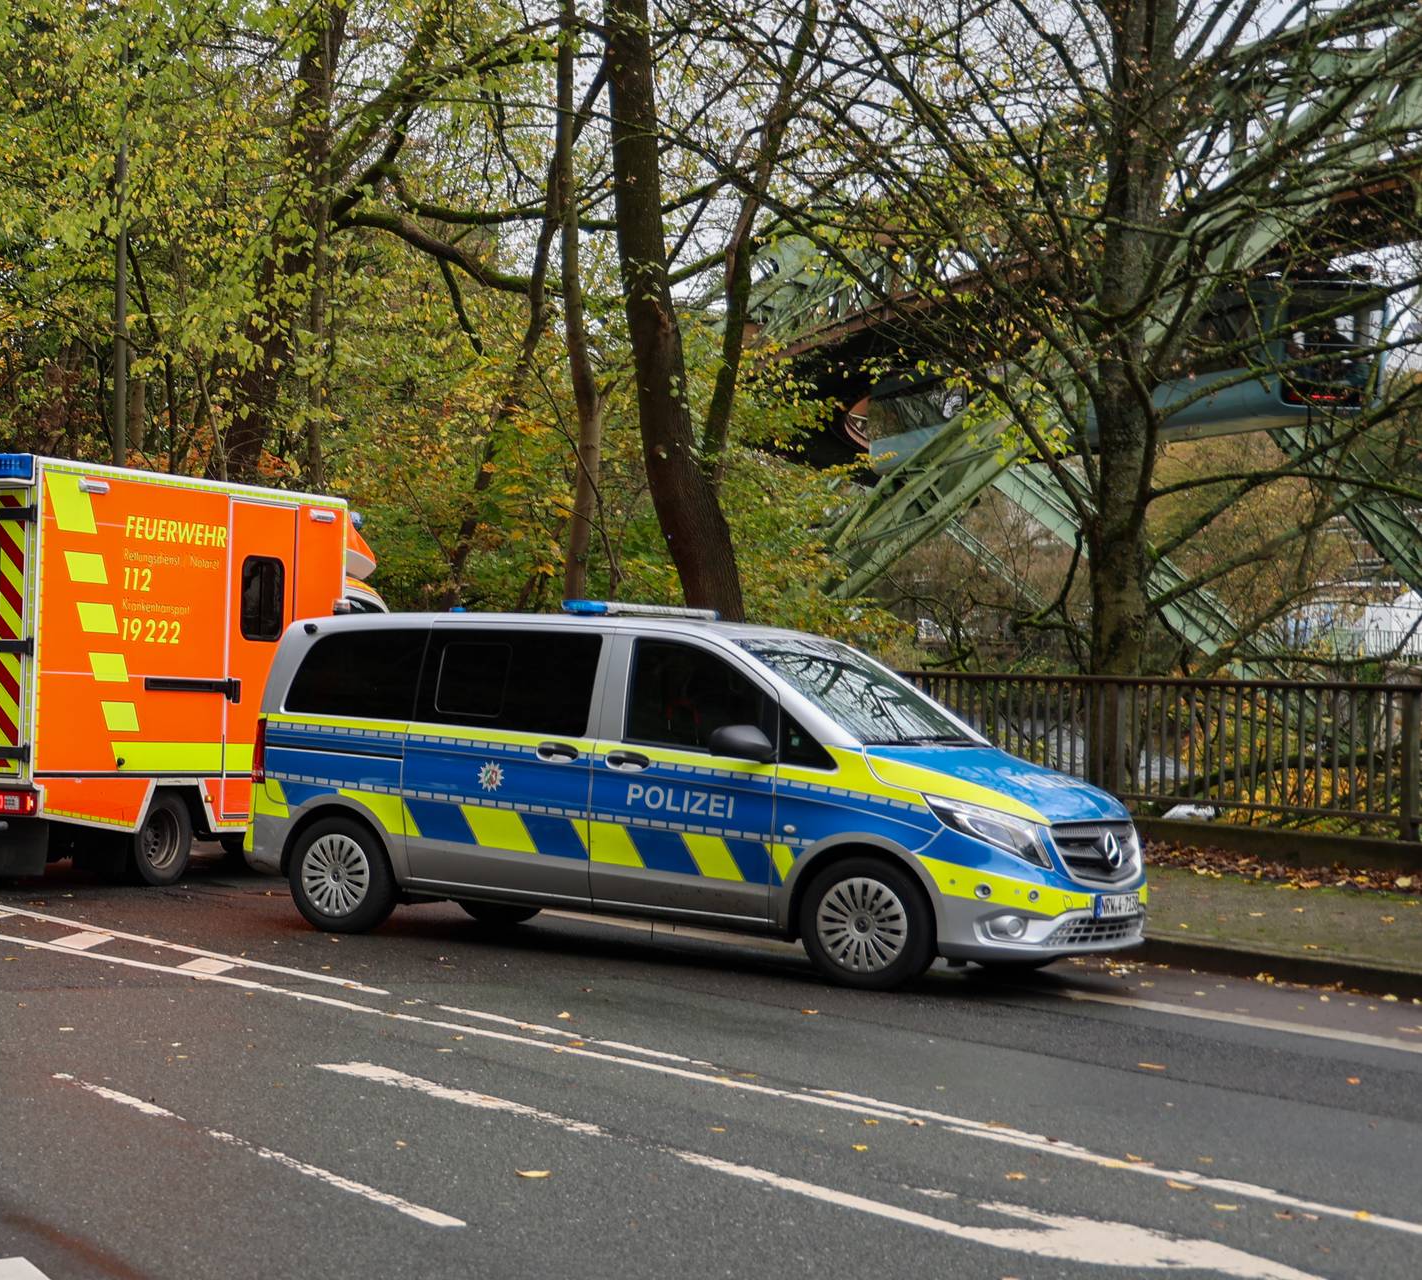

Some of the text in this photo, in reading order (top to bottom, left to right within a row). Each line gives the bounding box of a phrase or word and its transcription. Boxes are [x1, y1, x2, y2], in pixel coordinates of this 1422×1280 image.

[125, 515, 228, 548] FEUERWEHR
[123, 548, 180, 566] Rettungsdienst
[123, 567, 152, 592] 112
[122, 598, 191, 615] Krankentransport
[626, 783, 735, 819] POLIZEI
